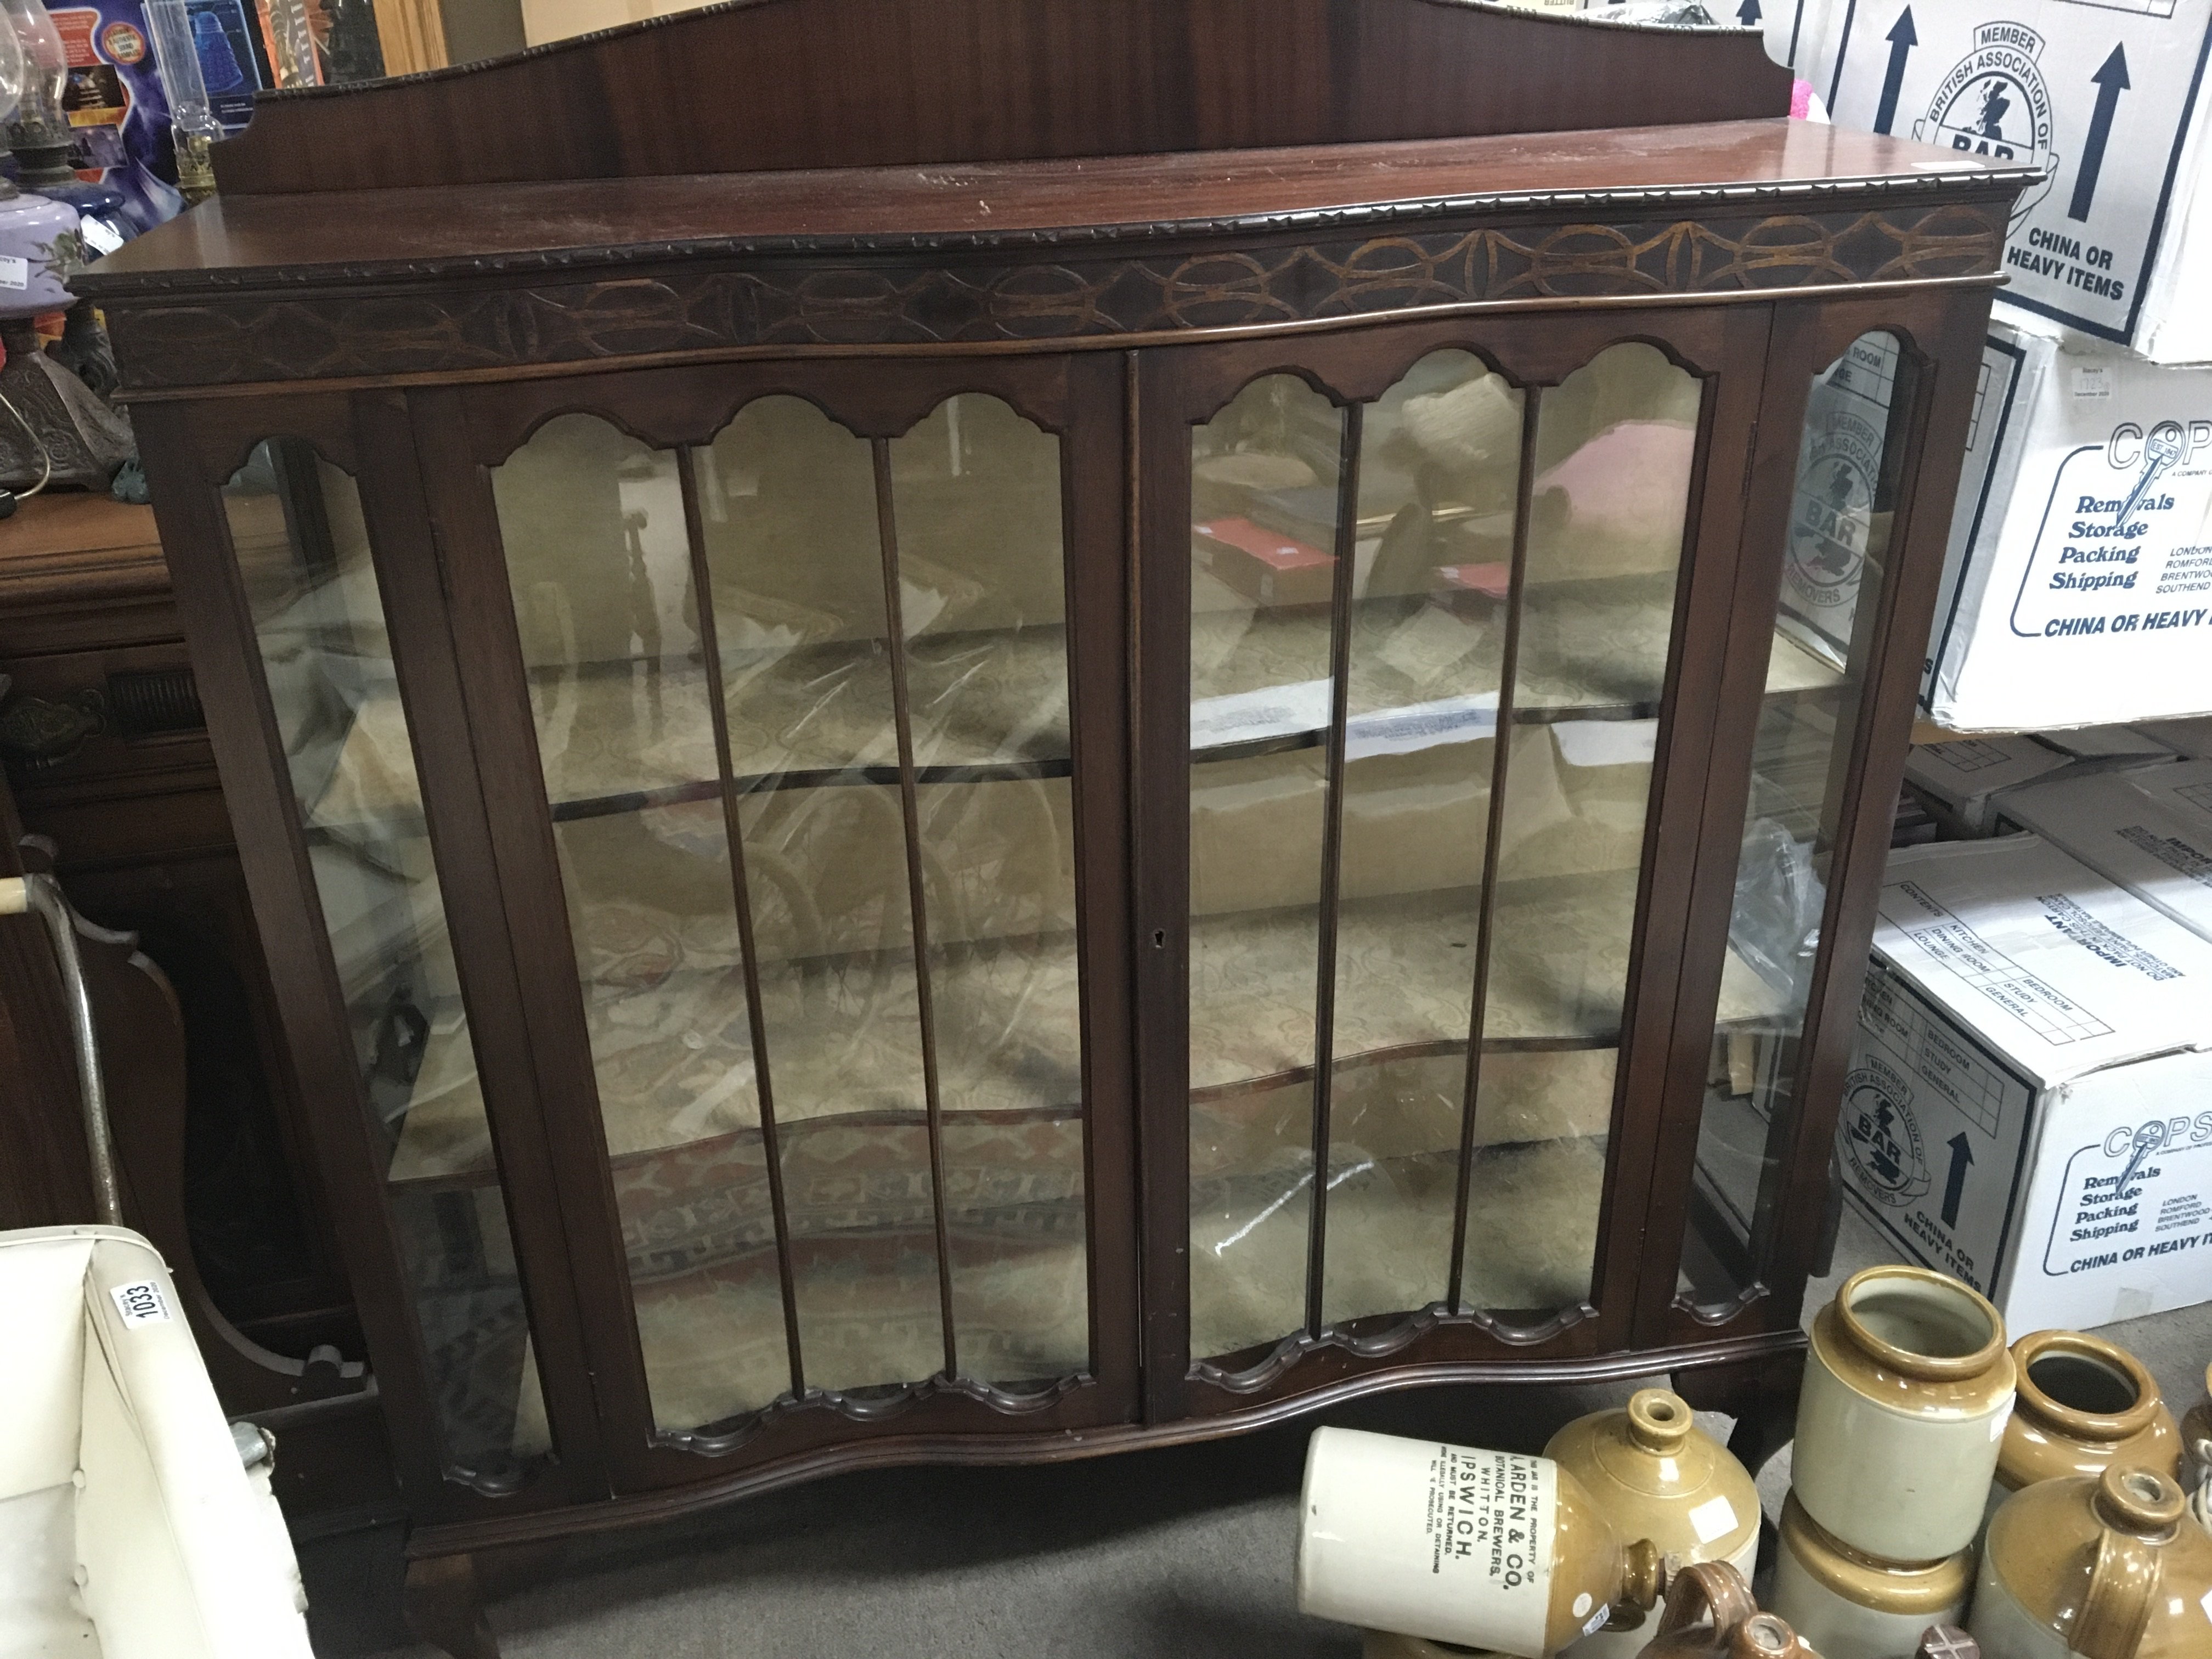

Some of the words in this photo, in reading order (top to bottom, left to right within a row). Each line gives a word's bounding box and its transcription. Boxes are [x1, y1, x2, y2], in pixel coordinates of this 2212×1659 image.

[1981, 27, 2036, 54] MEMBER
[1929, 60, 1973, 122] BRITISH
[1977, 50, 2047, 119] ASSOCIATION
[2038, 123, 2048, 150] OF
[2029, 227, 2080, 261] CHINA
[2086, 245, 2113, 270] OR
[2007, 246, 2066, 280] HEAVY
[2067, 266, 2124, 300] ITEMS
[1853, 347, 1882, 368] ROOM
[2075, 493, 2175, 514] Remvals
[1805, 498, 1855, 547] BAR
[2068, 521, 2148, 539] Storage
[2058, 546, 2141, 564] Packing
[2049, 571, 2138, 591] Shipping
[2155, 582, 2211, 594] SOUTHEND
[2045, 616, 2106, 637] CHINA
[2111, 614, 2140, 633] OR
[2141, 608, 2208, 630] HEAVY
[1900, 884, 1944, 917] CONTENTS
[2035, 896, 2071, 922] CARTON
[1914, 933, 1950, 960] LOUNGE
[1932, 929, 1963, 953] DINING
[1962, 954, 1991, 972] ROOM
[1950, 924, 1989, 954] KITCHEN
[2044, 915, 2127, 967] IMPORTANT
[2125, 960, 2149, 971] NOT
[2146, 971, 2164, 981] DO
[1985, 987, 2028, 1017] GENERAL
[2004, 983, 2038, 1003] STUDY
[2023, 979, 2073, 1011] BEDROOM
[1884, 1013, 1909, 1039] ROOM
[1925, 1048, 1951, 1074] STUDY
[1928, 1030, 1970, 1071] BEDROOM
[1871, 1059, 1908, 1096] MEMBER
[1922, 1065, 1960, 1103] GENERAL
[1870, 1074, 1920, 1143] ASSOCIATION
[1858, 1114, 1901, 1165] BAR
[1849, 1158, 1897, 1204] REMOVERS
[2083, 1166, 2162, 1190] Remvals
[2080, 1187, 2143, 1207] Storage
[2160, 1201, 2202, 1215] ROMFORD
[2162, 1194, 2198, 1206] LONDON
[2075, 1203, 2138, 1224] Packing
[2155, 1217, 2200, 1232] SOUTHEND
[2158, 1207, 2210, 1223] BRENTWOOD
[1917, 1211, 1953, 1251] CHINA
[1957, 1249, 1974, 1272] OR
[2070, 1219, 2139, 1242] Shipping
[1904, 1213, 1943, 1254] HEAVY
[1945, 1252, 1982, 1294] ITEMS
[2070, 1252, 2118, 1273] CHINA
[2122, 1246, 2145, 1261] OR
[2148, 1235, 2200, 1257] HEAVY
[126, 1285, 159, 1318] 1033
[1449, 1466, 1457, 1486] MUST
[1494, 1455, 1505, 1503] BOTANICAL
[1436, 1492, 1444, 1513] USING
[1448, 1490, 1457, 1500] BE
[1509, 1464, 1527, 1521] ARDEN
[1530, 1496, 1538, 1512] THE
[1454, 1455, 1476, 1560] IPSWICH.
[1435, 1517, 1443, 1528] OR
[1508, 1528, 1525, 1544] &
[1432, 1533, 1442, 1574] DETAINING
[1528, 1517, 1538, 1565] PROPERTY
[1503, 1554, 1523, 1590] CO.
[1526, 1570, 1534, 1583] OF
